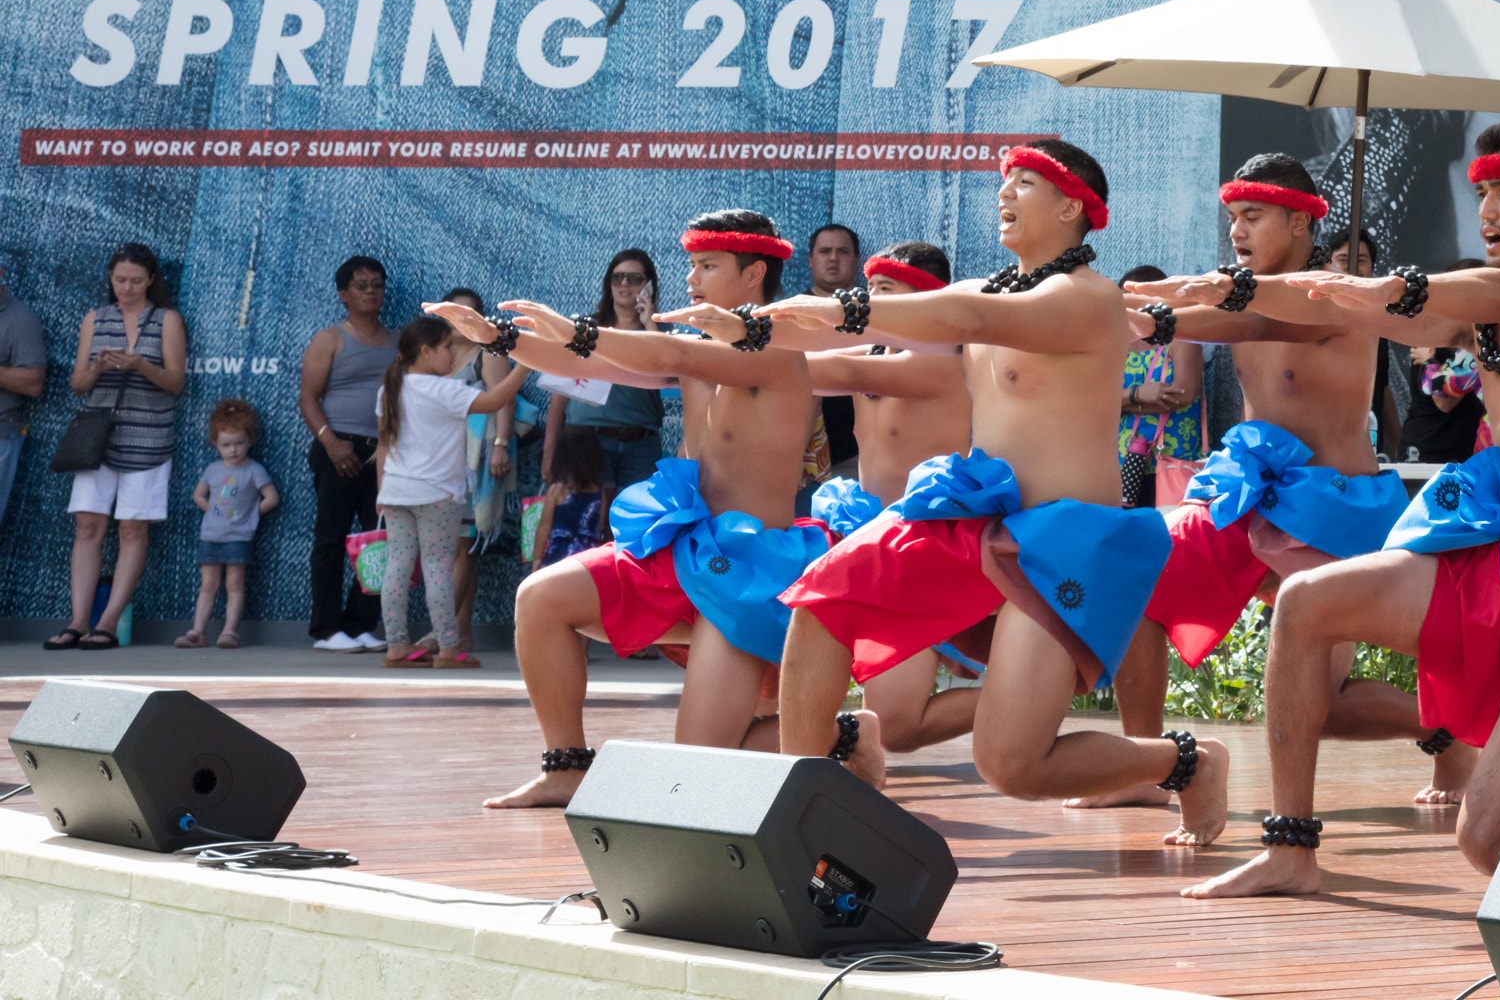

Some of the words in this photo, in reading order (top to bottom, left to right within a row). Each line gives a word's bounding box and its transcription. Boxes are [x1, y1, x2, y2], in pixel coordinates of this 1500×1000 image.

[35, 140, 94, 156] WANT
[101, 140, 127, 157] TO
[134, 141, 196, 157] WORK
[202, 141, 242, 157] FOR
[248, 141, 301, 157] AEO?
[307, 141, 382, 158] SUBMIT
[388, 142, 443, 158] YOUR
[449, 142, 528, 159] RESUME
[534, 142, 611, 159] ONLINE
[616, 143, 642, 159] AT
[648, 143, 1010, 161] WWW.LIVEYOURLIFELOVEYOURJOB.C
[185, 356, 245, 374] LLOW
[251, 357, 279, 375] US
